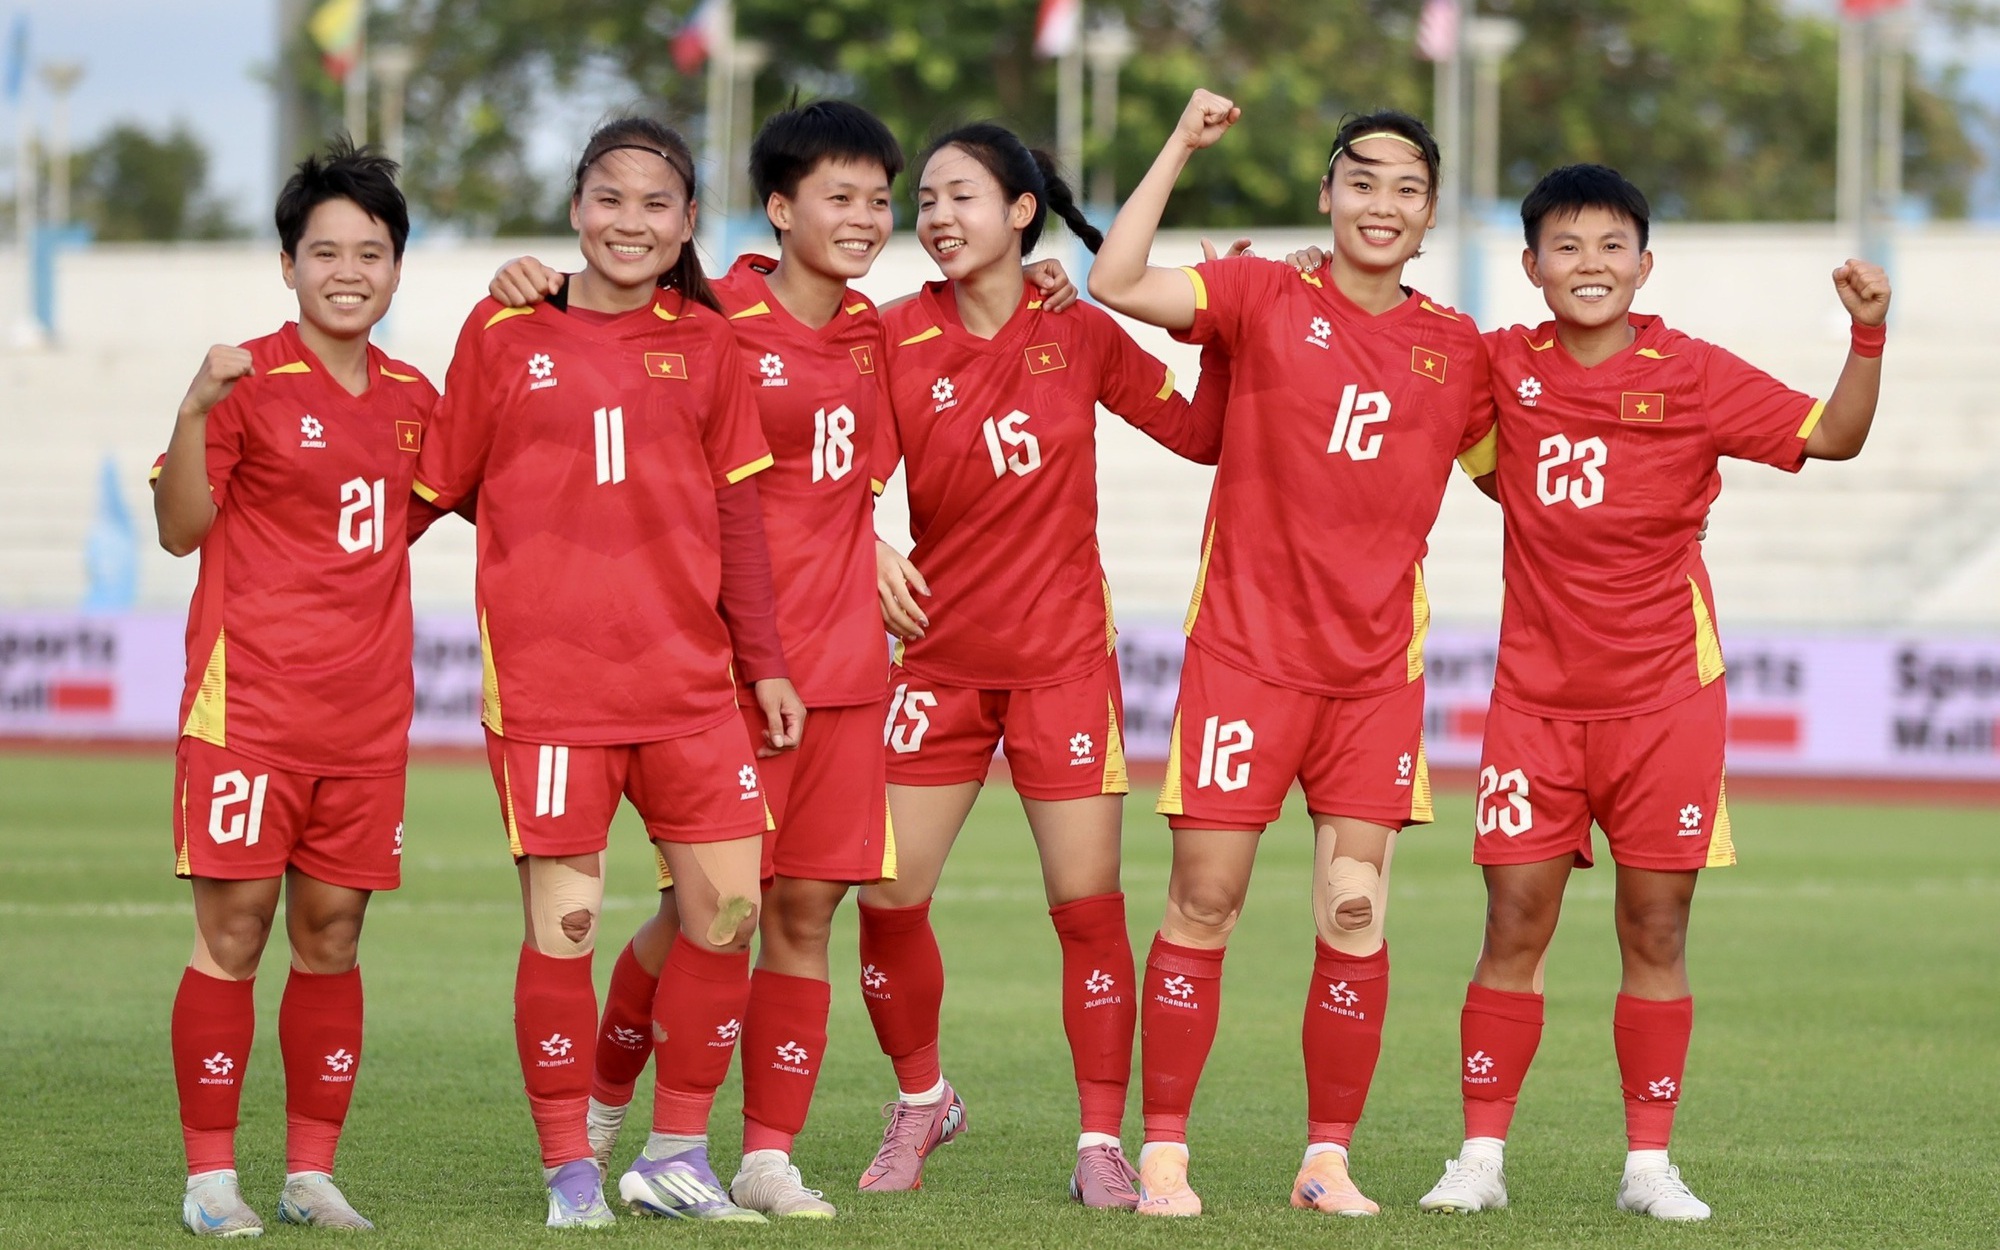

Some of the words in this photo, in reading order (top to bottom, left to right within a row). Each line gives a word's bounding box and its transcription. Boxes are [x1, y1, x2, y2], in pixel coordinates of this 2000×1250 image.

[593, 406, 626, 486] 11
[811, 404, 856, 484] 18
[982, 409, 1042, 478] 15
[1326, 384, 1392, 462] 12
[1536, 433, 1608, 510] 23
[337, 476, 385, 555] 21
[884, 683, 938, 754] 15
[1197, 715, 1254, 793] 12
[208, 769, 268, 847] 21
[535, 744, 569, 818] 11
[1476, 764, 1533, 838] 23
